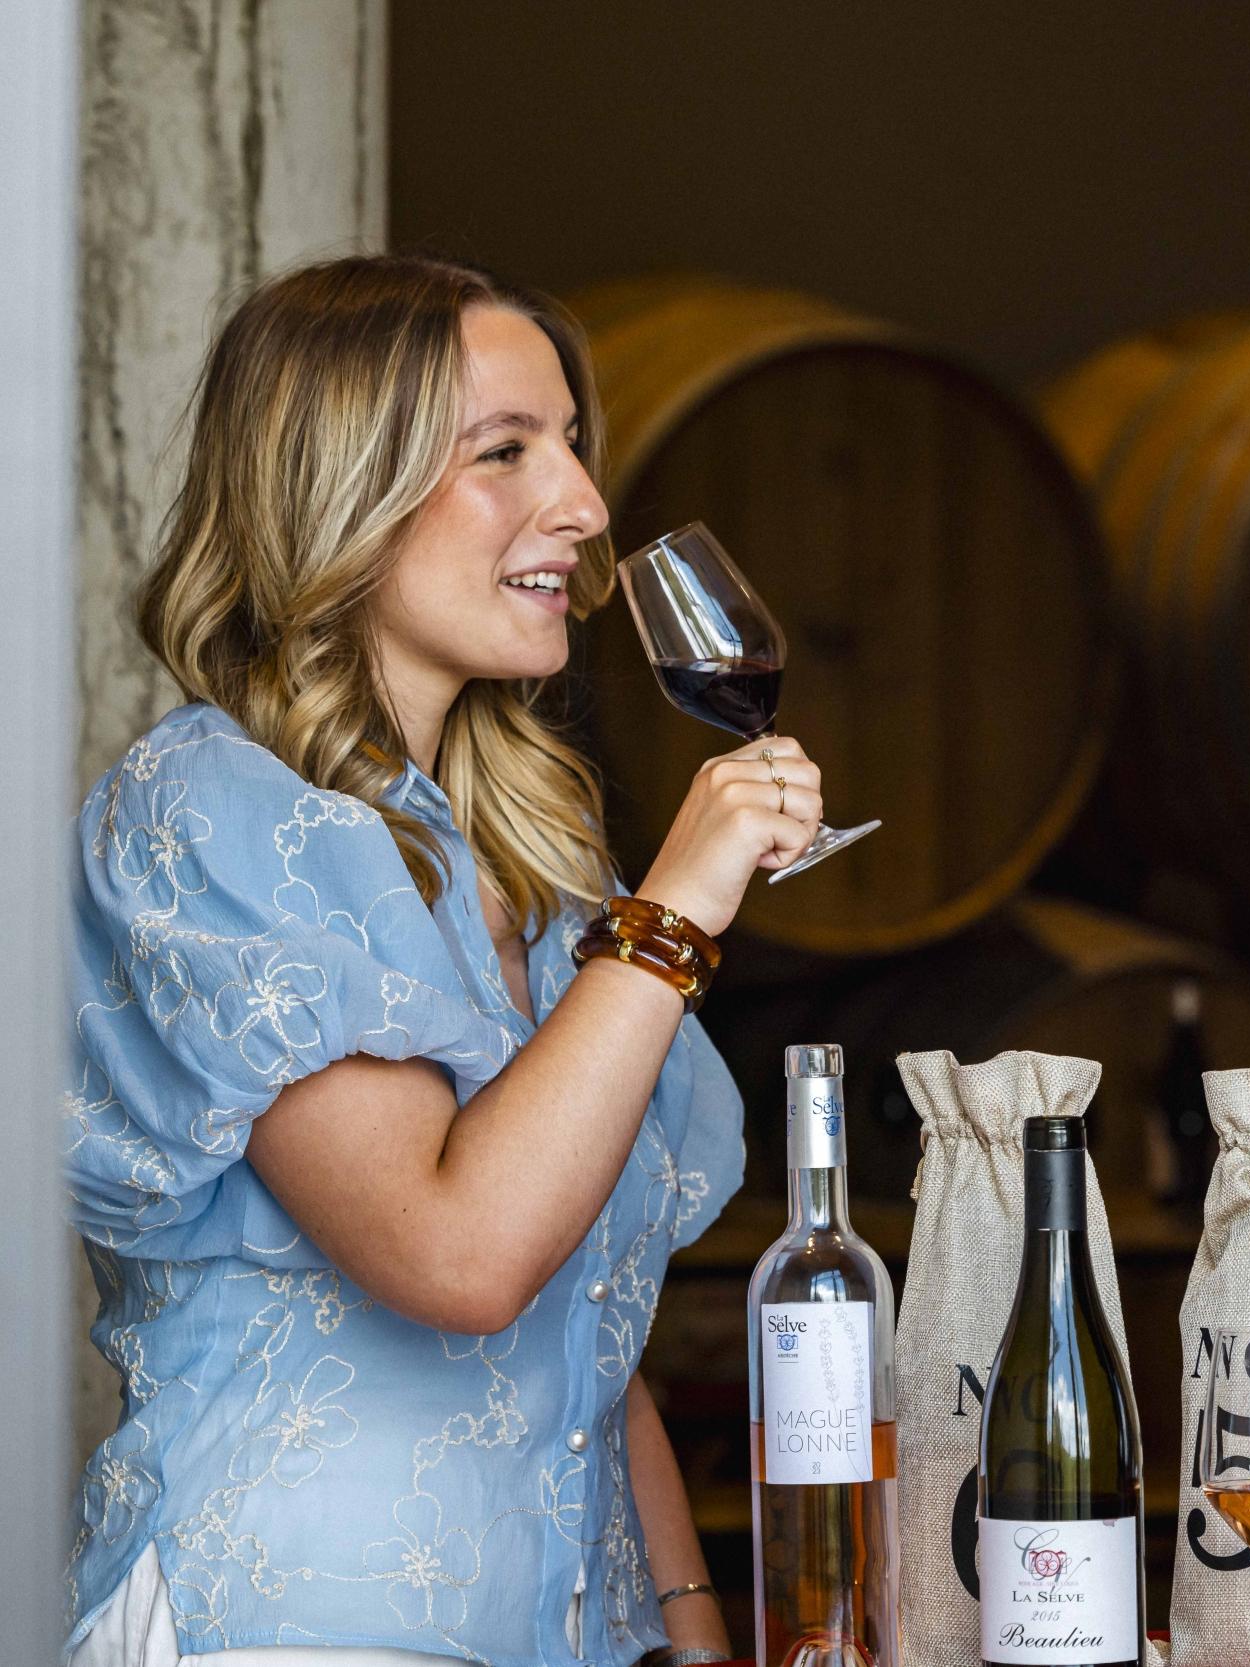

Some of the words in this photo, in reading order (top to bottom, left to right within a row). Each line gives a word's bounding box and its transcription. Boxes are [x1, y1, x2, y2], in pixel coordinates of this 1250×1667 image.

[812, 1095, 844, 1115] Selv
[768, 1315, 807, 1333] Selve
[777, 1408, 857, 1429] MAGUE
[777, 1432, 857, 1453] LONNE
[1012, 1590, 1032, 1602] LA
[1037, 1591, 1085, 1603] SELVE
[999, 1622, 1104, 1649] Beaulieu
